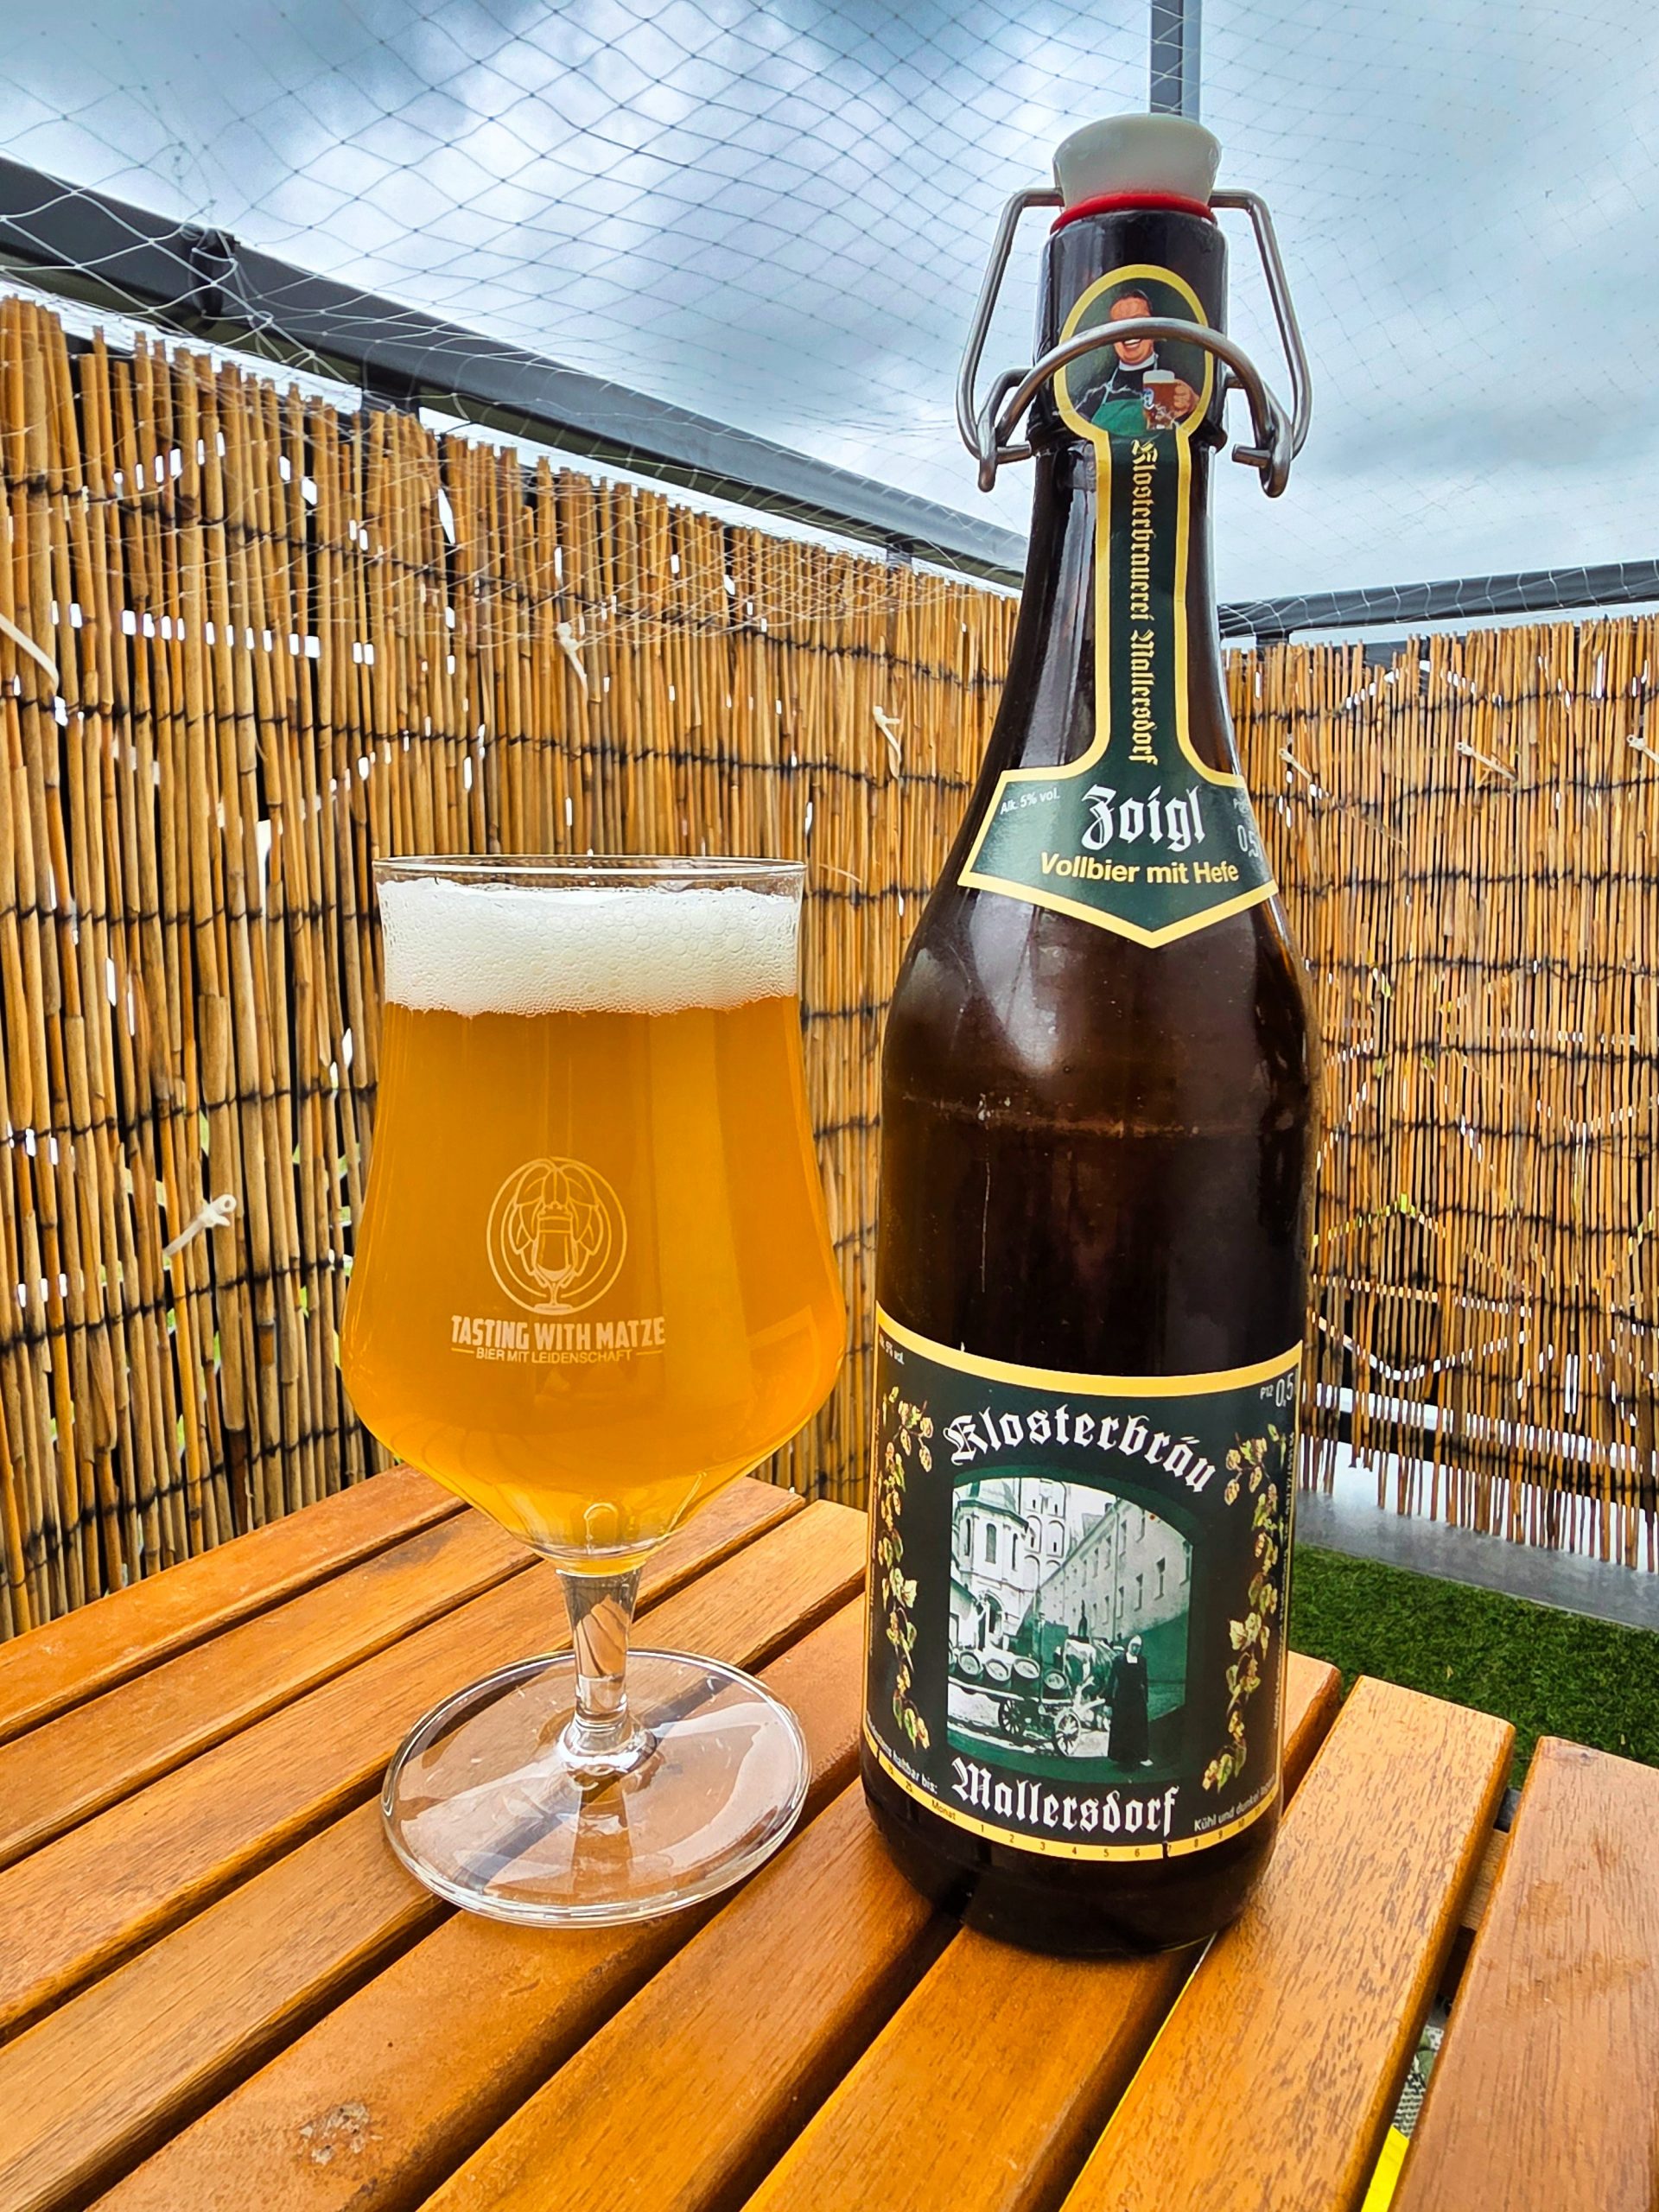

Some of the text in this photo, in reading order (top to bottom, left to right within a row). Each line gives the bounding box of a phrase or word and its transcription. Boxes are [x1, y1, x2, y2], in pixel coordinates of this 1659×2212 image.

[1128, 439, 1159, 766] Klosterbrauerei Mallersdorf
[1020, 791, 1038, 808] 5%
[1039, 787, 1060, 803] vol.
[1081, 784, 1206, 853] Zoigl
[1040, 852, 1240, 884] Vollbier mit Hefe
[451, 1315, 666, 1351] TASTING WITH MATZE
[476, 1347, 632, 1364] BIER MIT LEIDENSCHAFT
[943, 1403, 1217, 1493] Klosterbräu
[950, 1757, 1179, 1838] Mallersdorf
[1194, 1813, 1217, 1833] Kühl
[1218, 1806, 1236, 1825] und
[1009, 1834, 1015, 1844] 2
[1039, 1840, 1046, 1852] 3
[1071, 1845, 1078, 1856] 4
[1103, 1847, 1109, 1859] 5
[1134, 1847, 1141, 1858] 6
